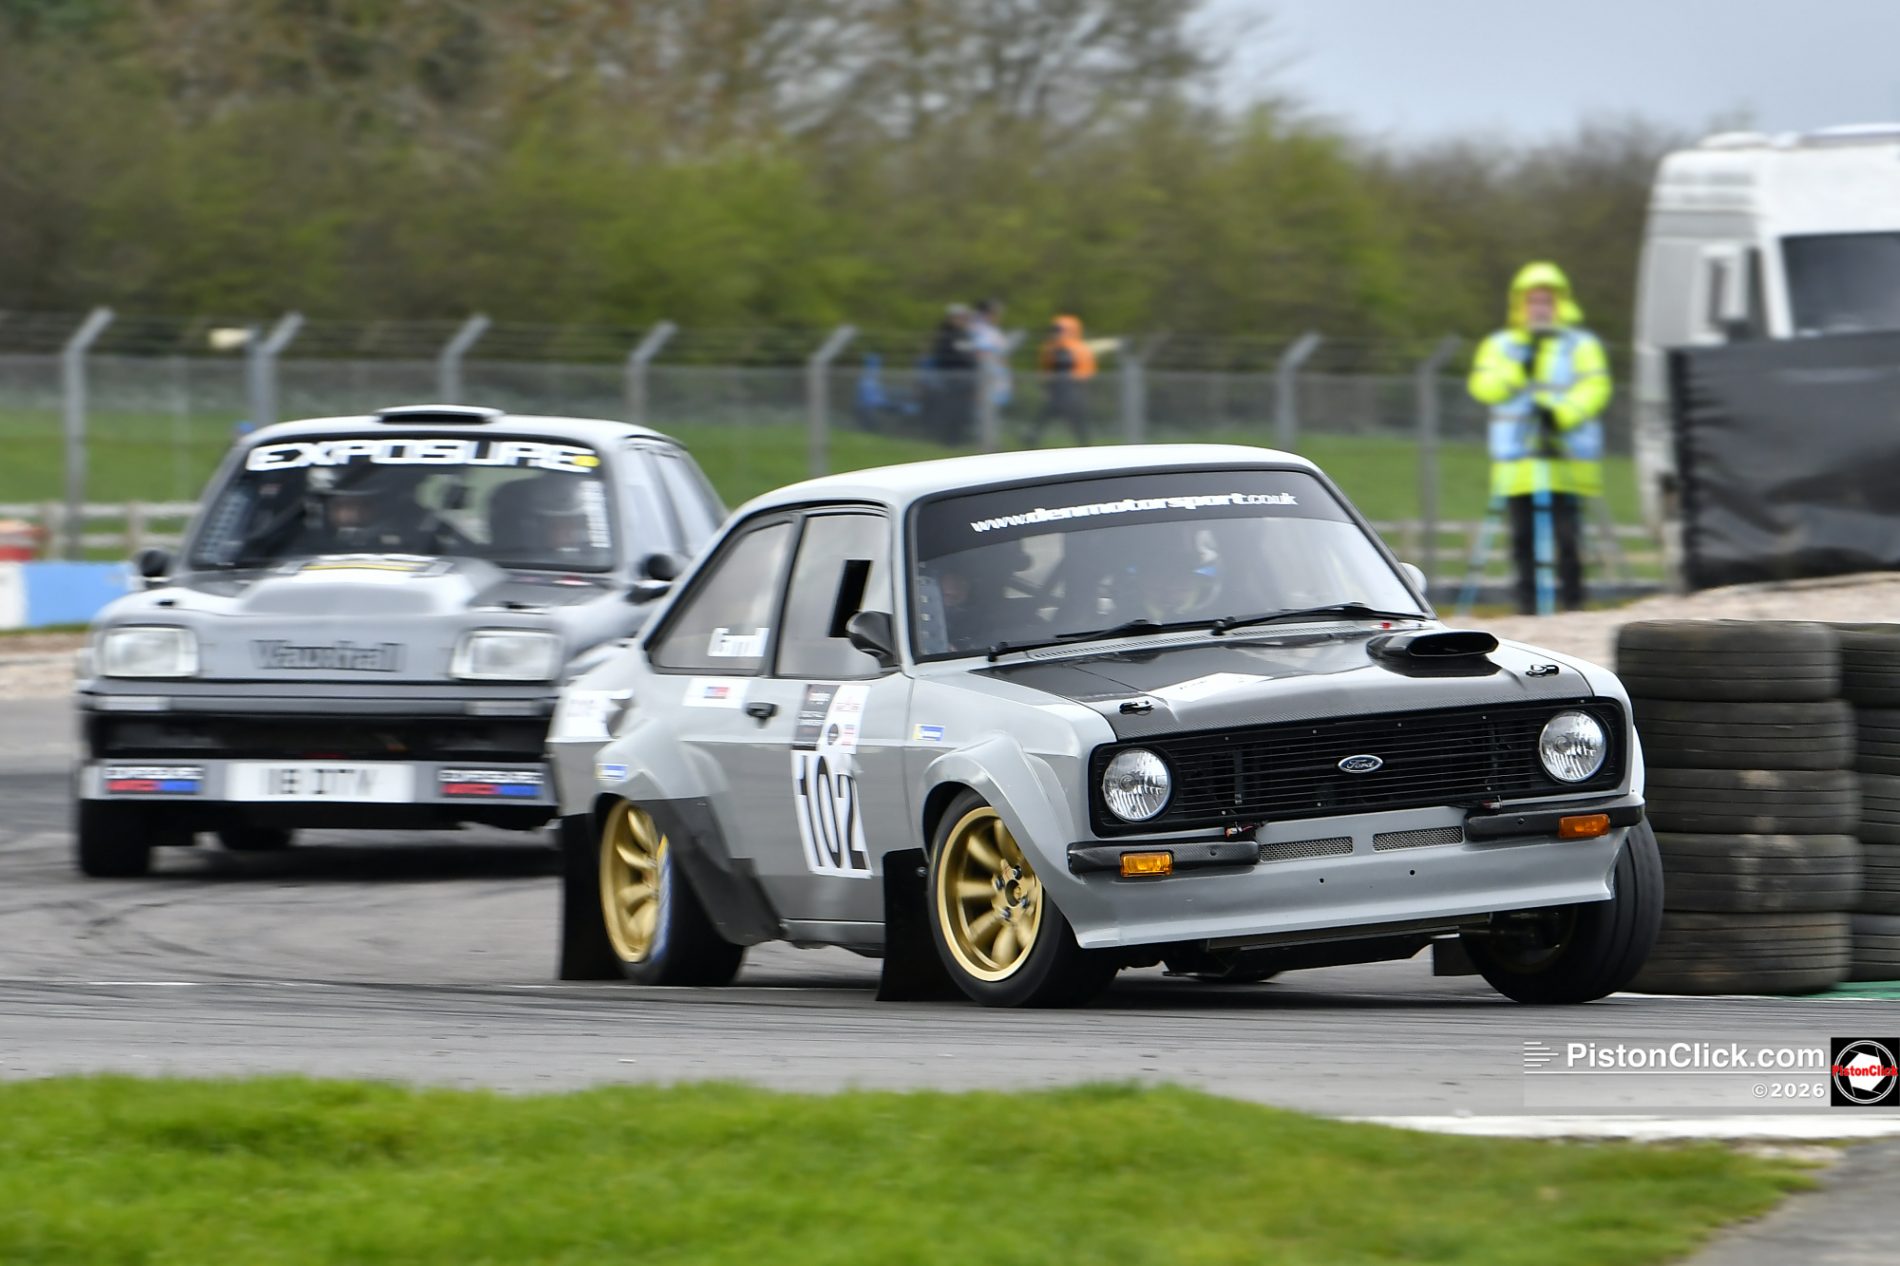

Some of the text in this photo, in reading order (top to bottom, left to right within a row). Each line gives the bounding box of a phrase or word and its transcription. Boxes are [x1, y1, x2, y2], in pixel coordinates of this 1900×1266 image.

[245, 438, 598, 473] EXPOSURE
[1346, 759, 1375, 769] Ford
[799, 754, 868, 871] 102
